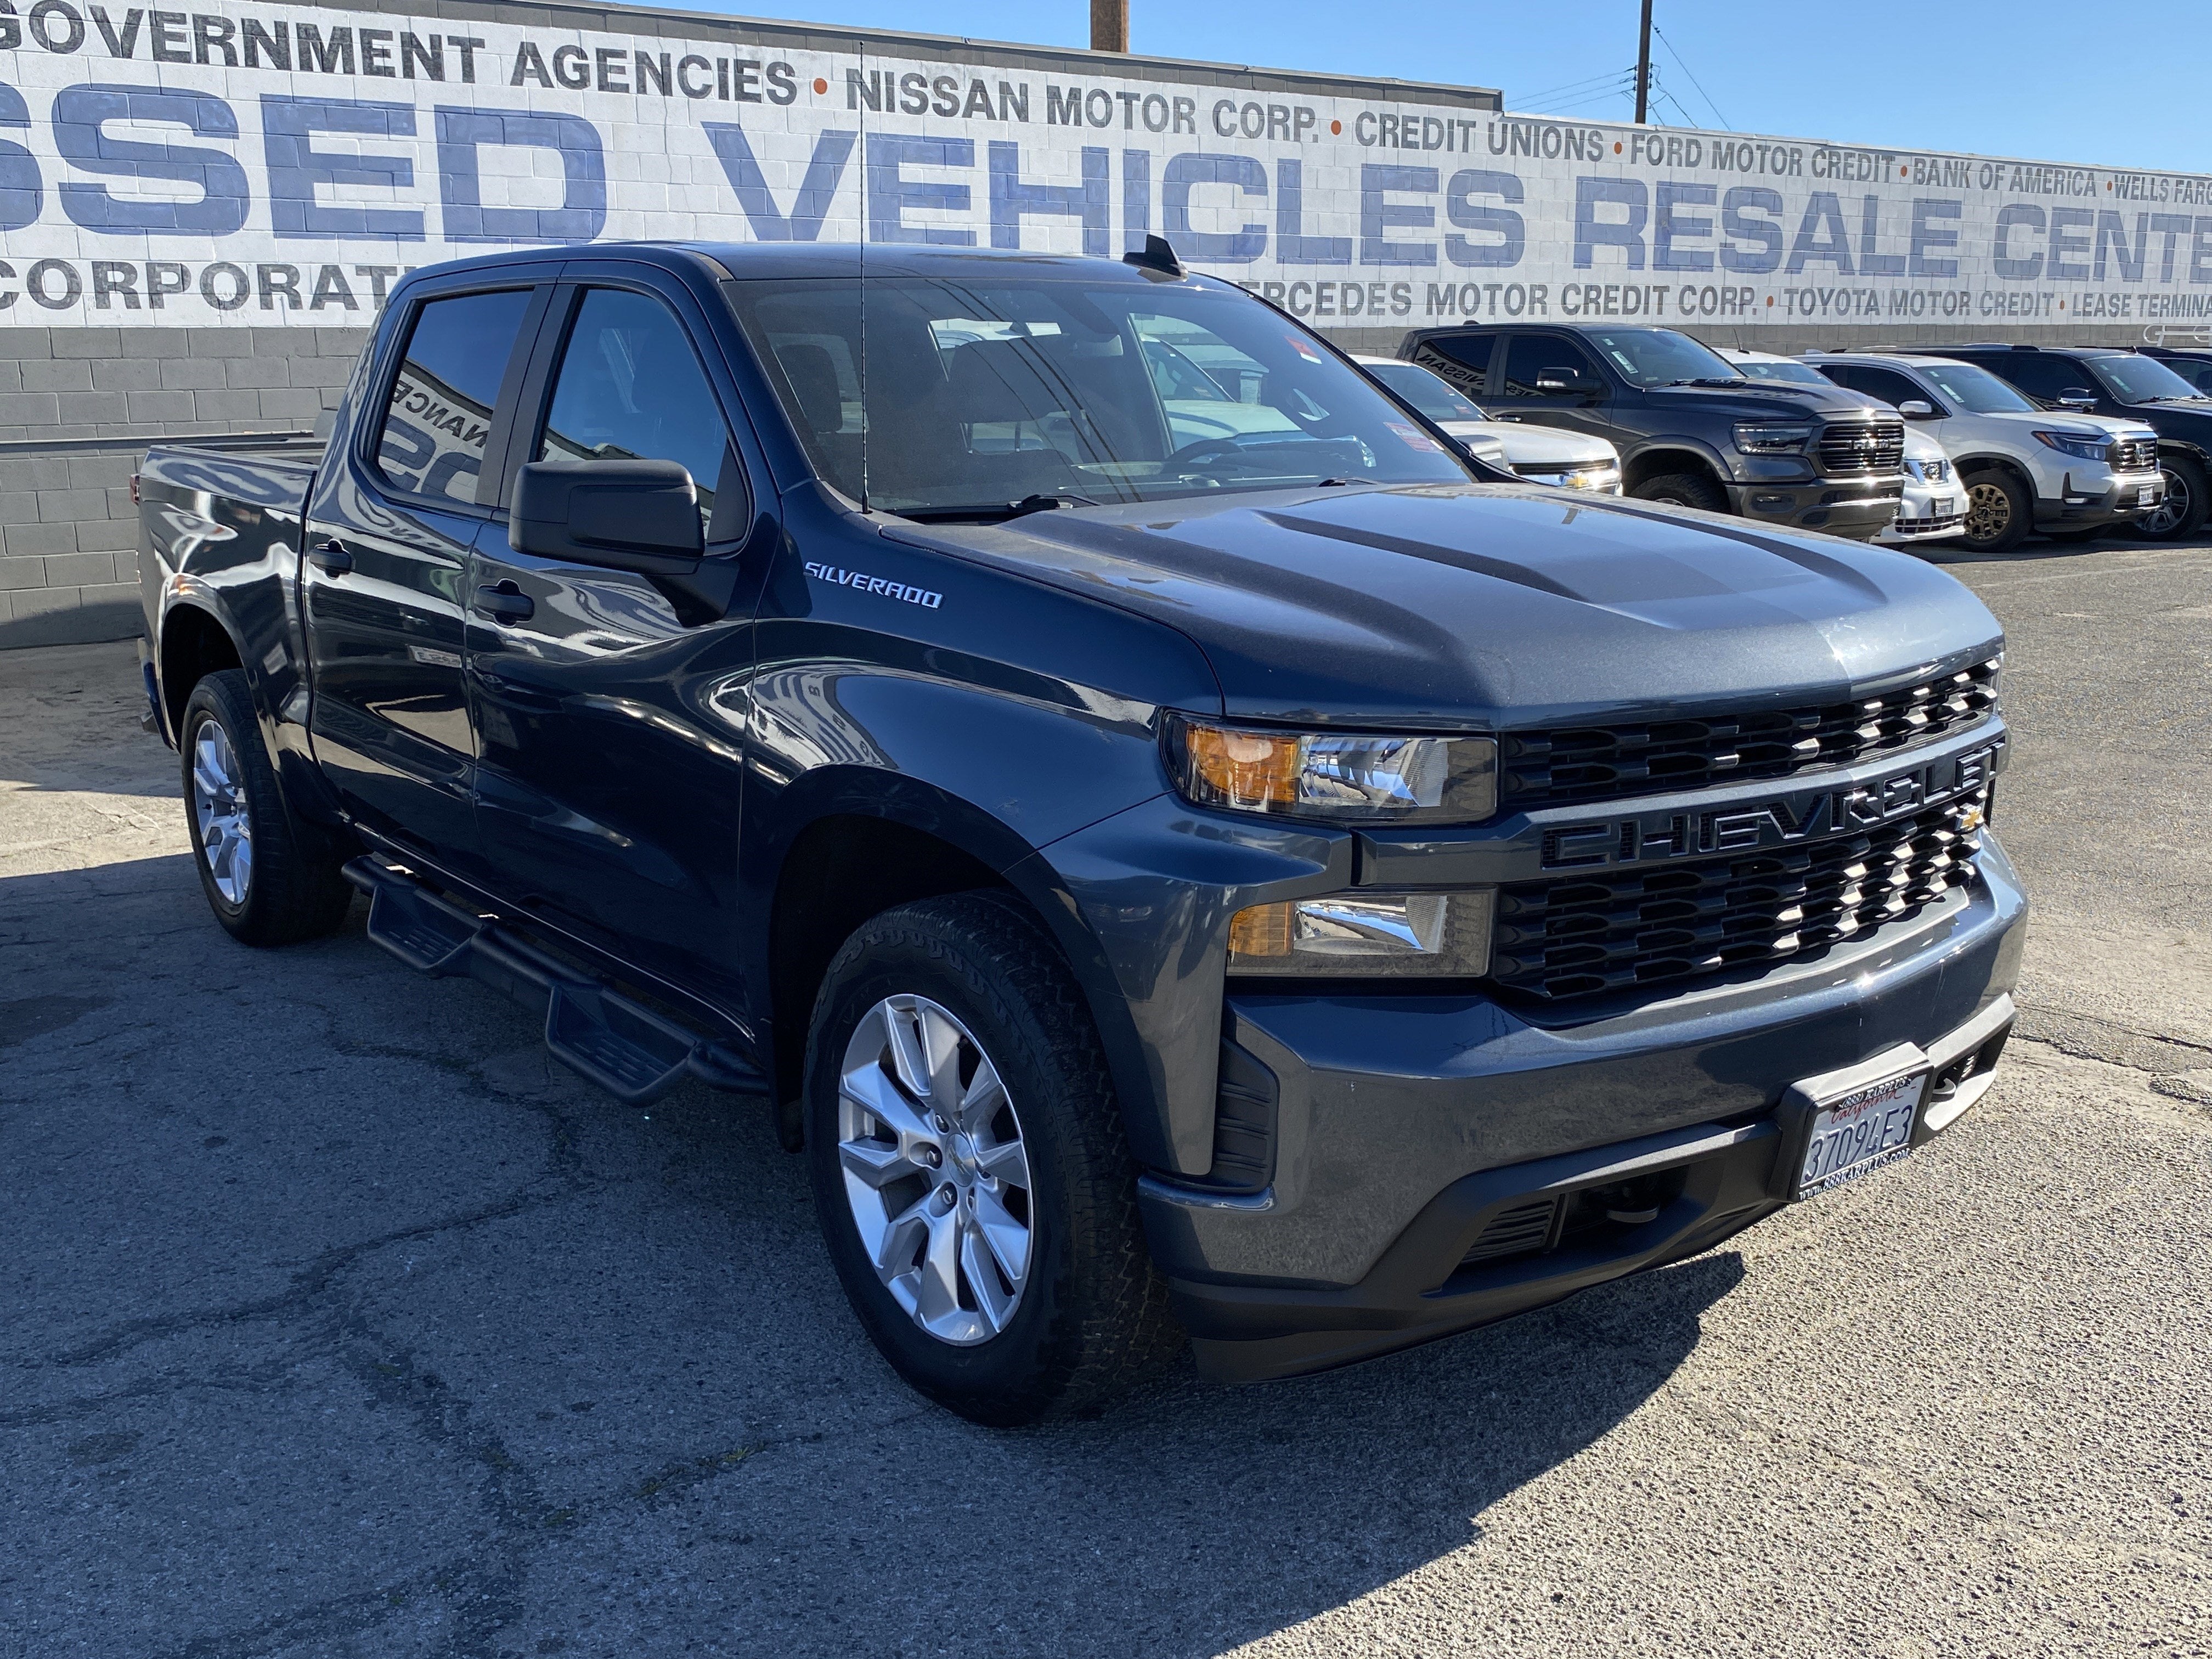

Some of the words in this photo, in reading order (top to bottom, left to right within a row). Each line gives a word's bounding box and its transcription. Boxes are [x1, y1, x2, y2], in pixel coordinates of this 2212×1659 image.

[510, 41, 798, 105] AGENCIES
[847, 68, 1029, 123] NISSAN
[1047, 84, 1196, 134] MOTOR
[1212, 99, 1318, 143] CORP.
[1355, 111, 1476, 153] CREDIT
[1488, 121, 1604, 162] UNIONS
[1630, 134, 1702, 168] FORD
[1712, 141, 1803, 177] MOTOR
[1812, 148, 1895, 183] CREDIT
[1914, 157, 1972, 189] BANK
[1979, 162, 2005, 191] OF
[2010, 166, 2097, 197] AMERICA
[2114, 174, 2169, 202] WELLS
[0, 81, 606, 245] SED
[701, 121, 1525, 268] VEHICLES
[1574, 176, 1962, 278] RESALE
[0, 258, 417, 311] ORPORAT
[1426, 283, 1548, 316] MOTOR
[1561, 284, 1669, 316] CREDIT
[1678, 285, 1757, 316] CORP.
[1784, 288, 1880, 317] TOYOTA
[1889, 289, 1971, 317] MOTOR
[1980, 291, 2055, 317] CREDIT
[2072, 293, 2132, 318] LEASE
[2137, 294, 2212, 318] TERMINA
[805, 561, 944, 609] SILVERADO
[1541, 741, 2006, 871] CHEVROLET
[1804, 1104, 1913, 1181] 37094E3
